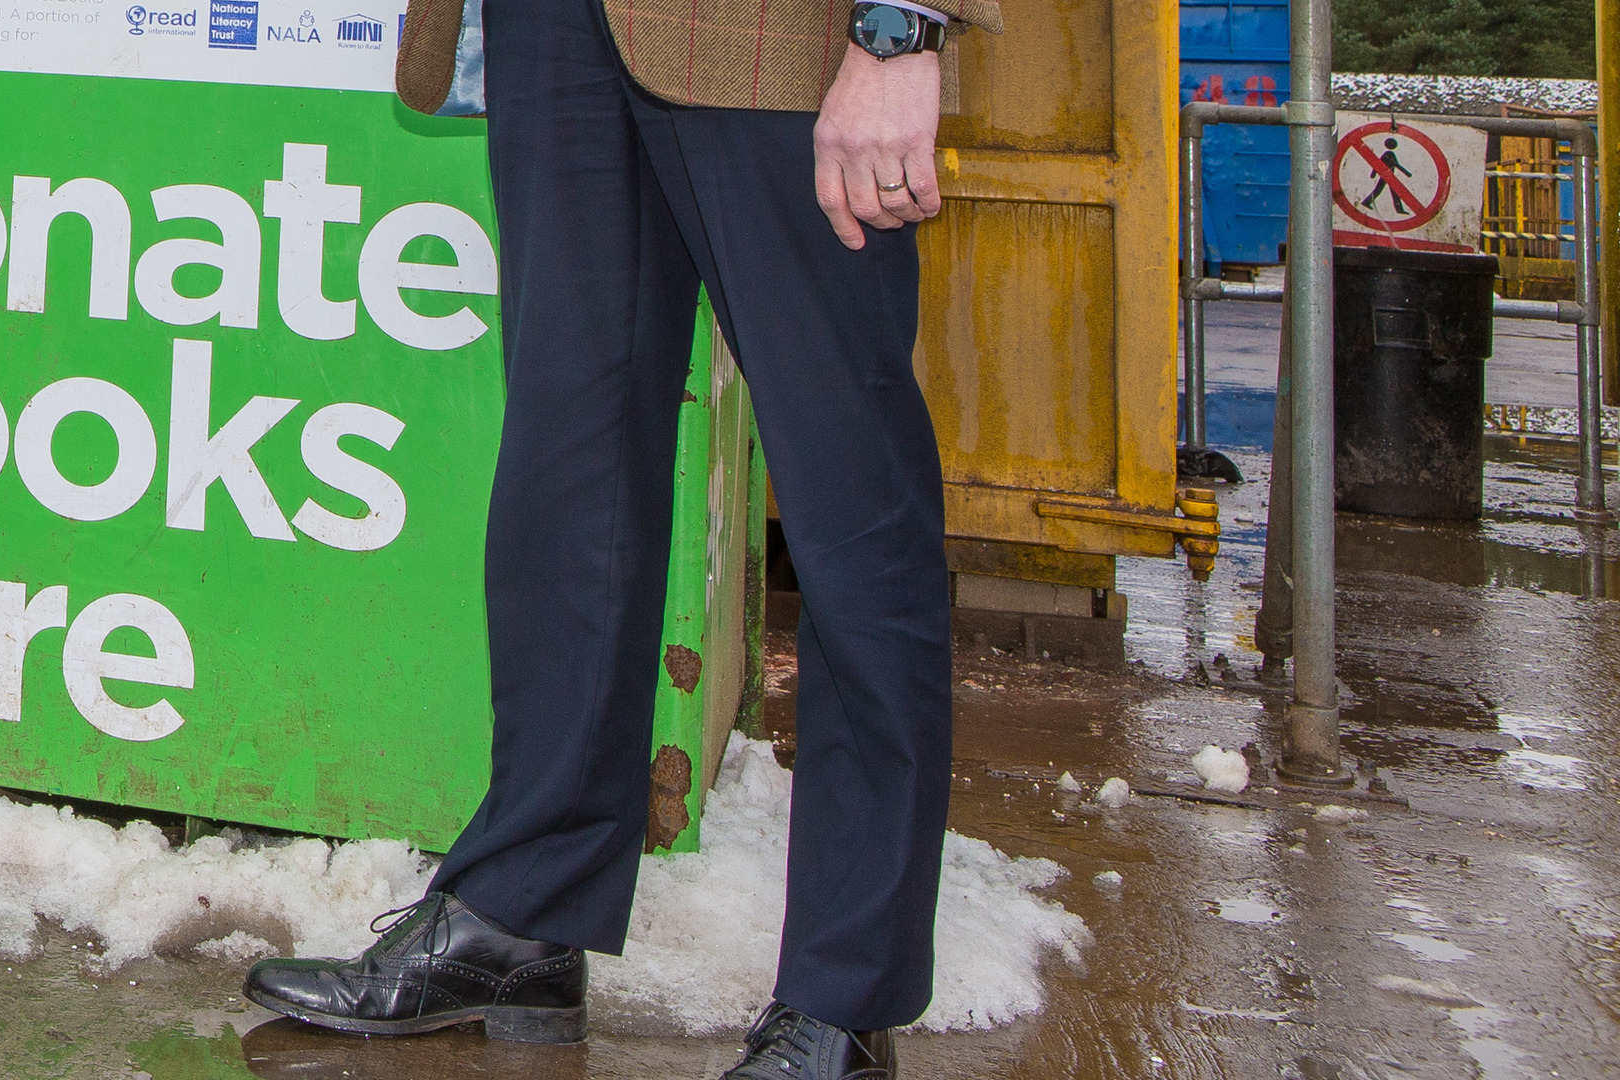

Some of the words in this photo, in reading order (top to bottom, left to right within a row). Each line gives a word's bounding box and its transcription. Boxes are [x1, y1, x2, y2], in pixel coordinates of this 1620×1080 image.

[211, 3, 257, 15] National
[9, 8, 21, 20] A
[25, 9, 80, 23] portion
[84, 11, 101, 24] of
[149, 9, 197, 27] read
[211, 17, 253, 29] Literacy
[15, 28, 40, 41] for:
[148, 28, 197, 37] international
[211, 29, 235, 40] Trust
[267, 26, 322, 43] NALA
